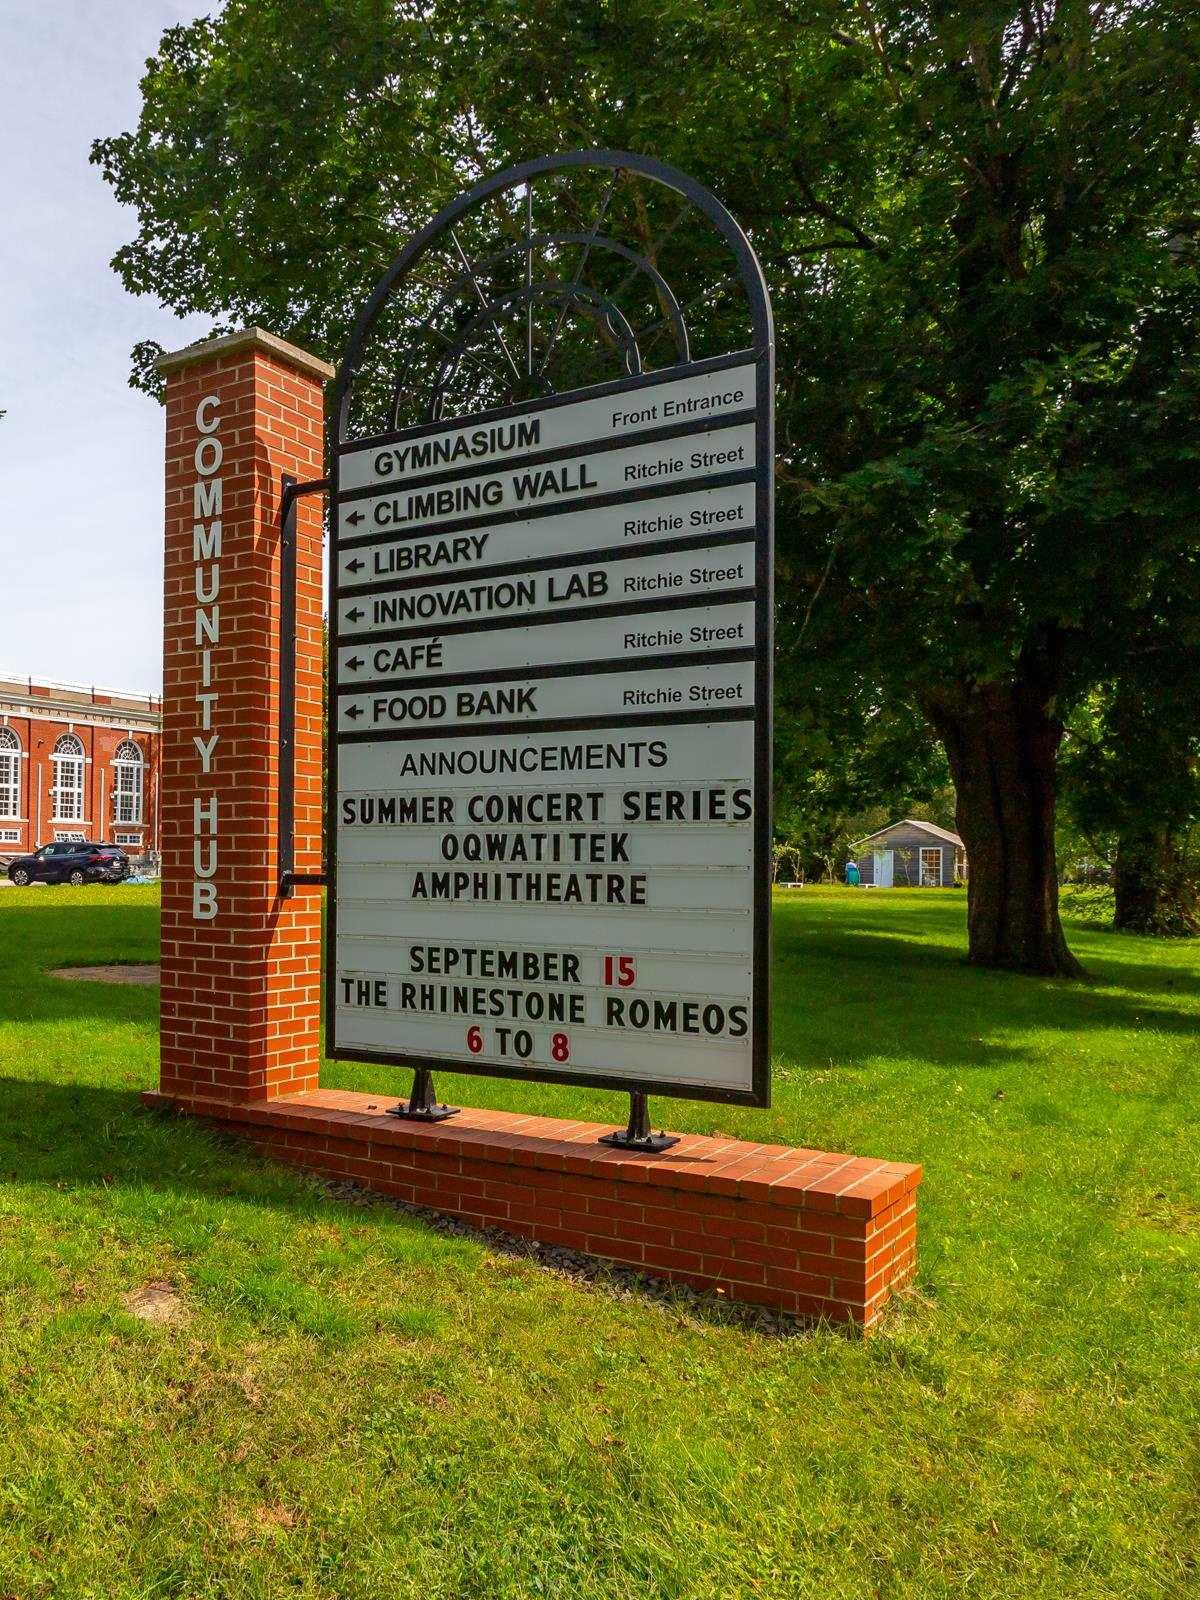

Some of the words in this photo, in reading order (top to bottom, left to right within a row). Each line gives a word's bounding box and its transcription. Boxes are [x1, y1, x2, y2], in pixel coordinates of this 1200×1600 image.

[612, 407, 658, 428] Front
[664, 388, 744, 417] Entrance
[374, 419, 541, 476] GYMNASIUM
[624, 457, 684, 482] Ritchie
[690, 446, 745, 470] Street
[373, 480, 503, 526] CLIMBING
[513, 464, 598, 501] WALL
[624, 514, 683, 537] Ritchie
[690, 504, 744, 527] Street
[374, 534, 490, 575] LIBRARY
[193, 395, 224, 774] COMMUNITY
[623, 571, 683, 593] Ritchie
[690, 563, 744, 585] Street
[373, 579, 536, 624] INNOVATION
[548, 570, 609, 602] LAB
[623, 628, 683, 650] Ritchie
[689, 622, 744, 643] Street
[373, 637, 443, 673] CAFÉ
[373, 694, 447, 722] FOOD
[456, 687, 538, 718] BANK
[623, 687, 682, 706] Ritchie
[689, 683, 743, 703] Street
[400, 741, 668, 777] ANNOUNCEMENTS
[342, 796, 454, 824] SUMMER
[468, 792, 604, 823] CONCERT
[623, 789, 752, 821] SERIES
[193, 797, 219, 920] HUB
[441, 833, 631, 862] OQWATITEK
[412, 872, 647, 905] AMPHITHEATRE
[410, 945, 581, 983] SEPTEMBER
[604, 955, 635, 987] 15
[341, 978, 387, 1007] THE
[402, 982, 585, 1024] RHINESTONE
[606, 997, 748, 1037] ROMEOS
[466, 1026, 483, 1054] 6
[495, 1027, 533, 1058] TO
[551, 1032, 570, 1062] 8
